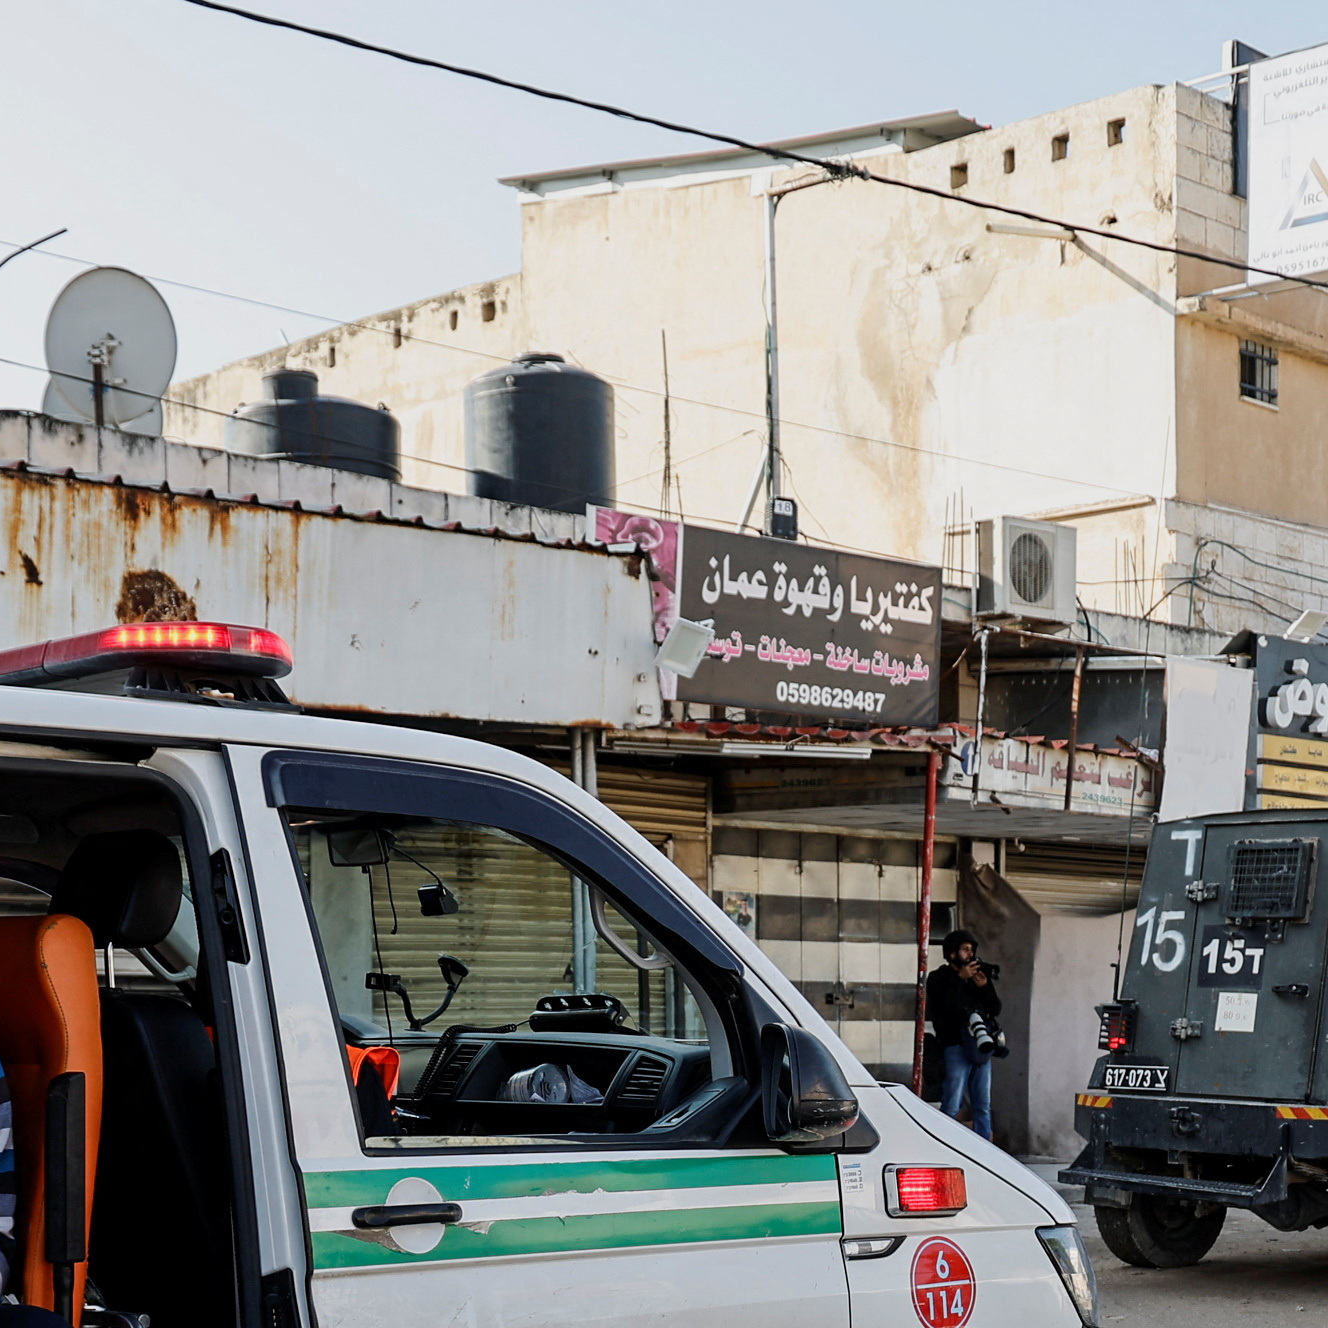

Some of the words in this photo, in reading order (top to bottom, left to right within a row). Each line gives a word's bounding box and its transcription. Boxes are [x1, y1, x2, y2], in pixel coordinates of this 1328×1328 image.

[1303, 190, 1324, 205] IRC
[702, 553, 769, 604] عمان
[773, 561, 844, 622] وقهوة
[850, 575, 934, 636] كفتيريا
[757, 635, 811, 670] معجنات
[825, 641, 870, 674] ساخنة
[871, 650, 929, 686] مشروبات
[776, 681, 885, 713] 0598629487
[1082, 792, 1123, 805] 2439623
[1136, 906, 1185, 972] 15
[936, 1250, 950, 1279] 6
[926, 1289, 964, 1321] 114
